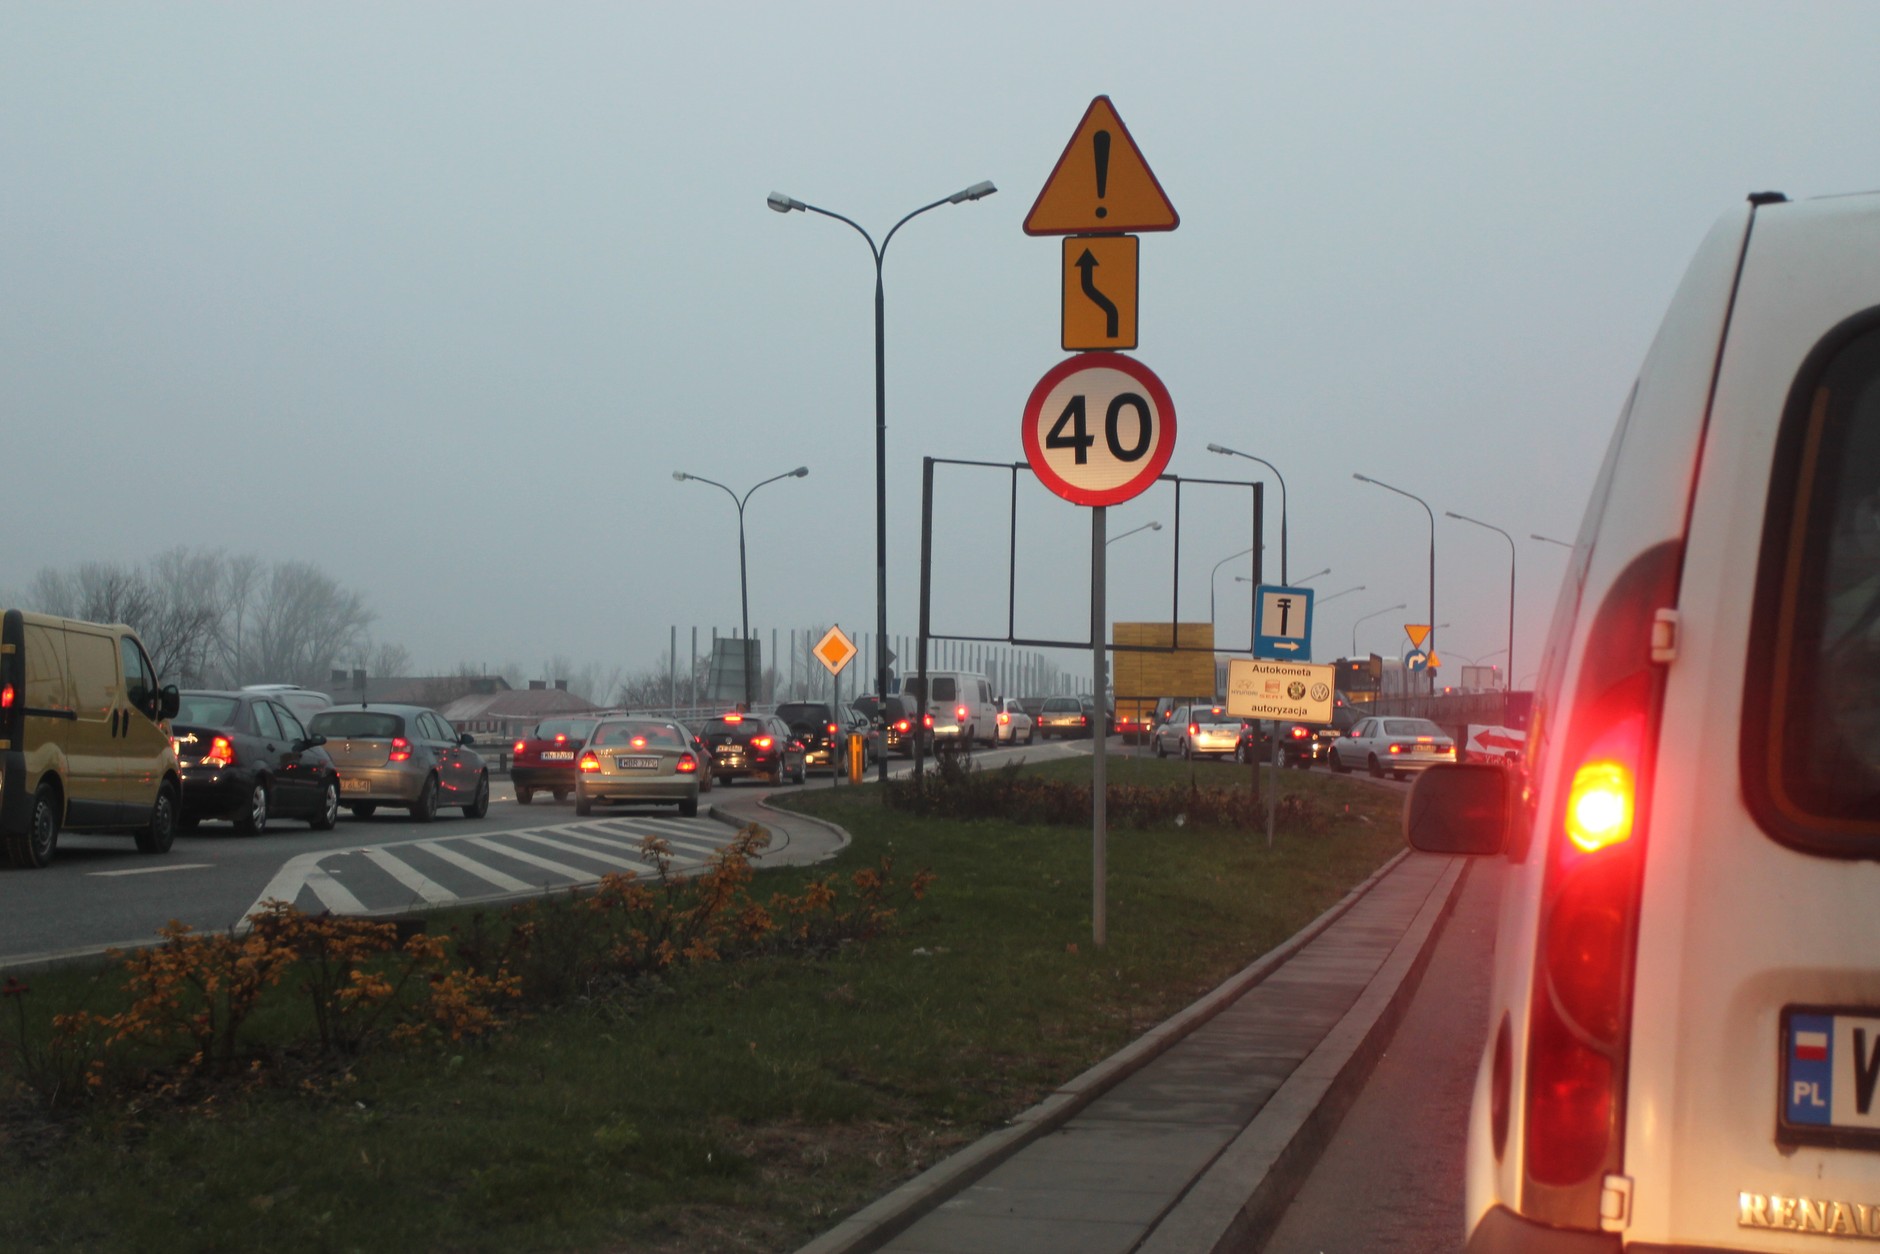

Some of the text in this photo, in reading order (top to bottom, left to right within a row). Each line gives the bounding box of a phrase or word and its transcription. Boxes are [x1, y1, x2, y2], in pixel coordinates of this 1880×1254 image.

[1046, 392, 1153, 465] 40
[1252, 664, 1311, 677] Autokometa
[1251, 704, 1308, 716] autoryzacja
[1793, 1081, 1825, 1107] PL
